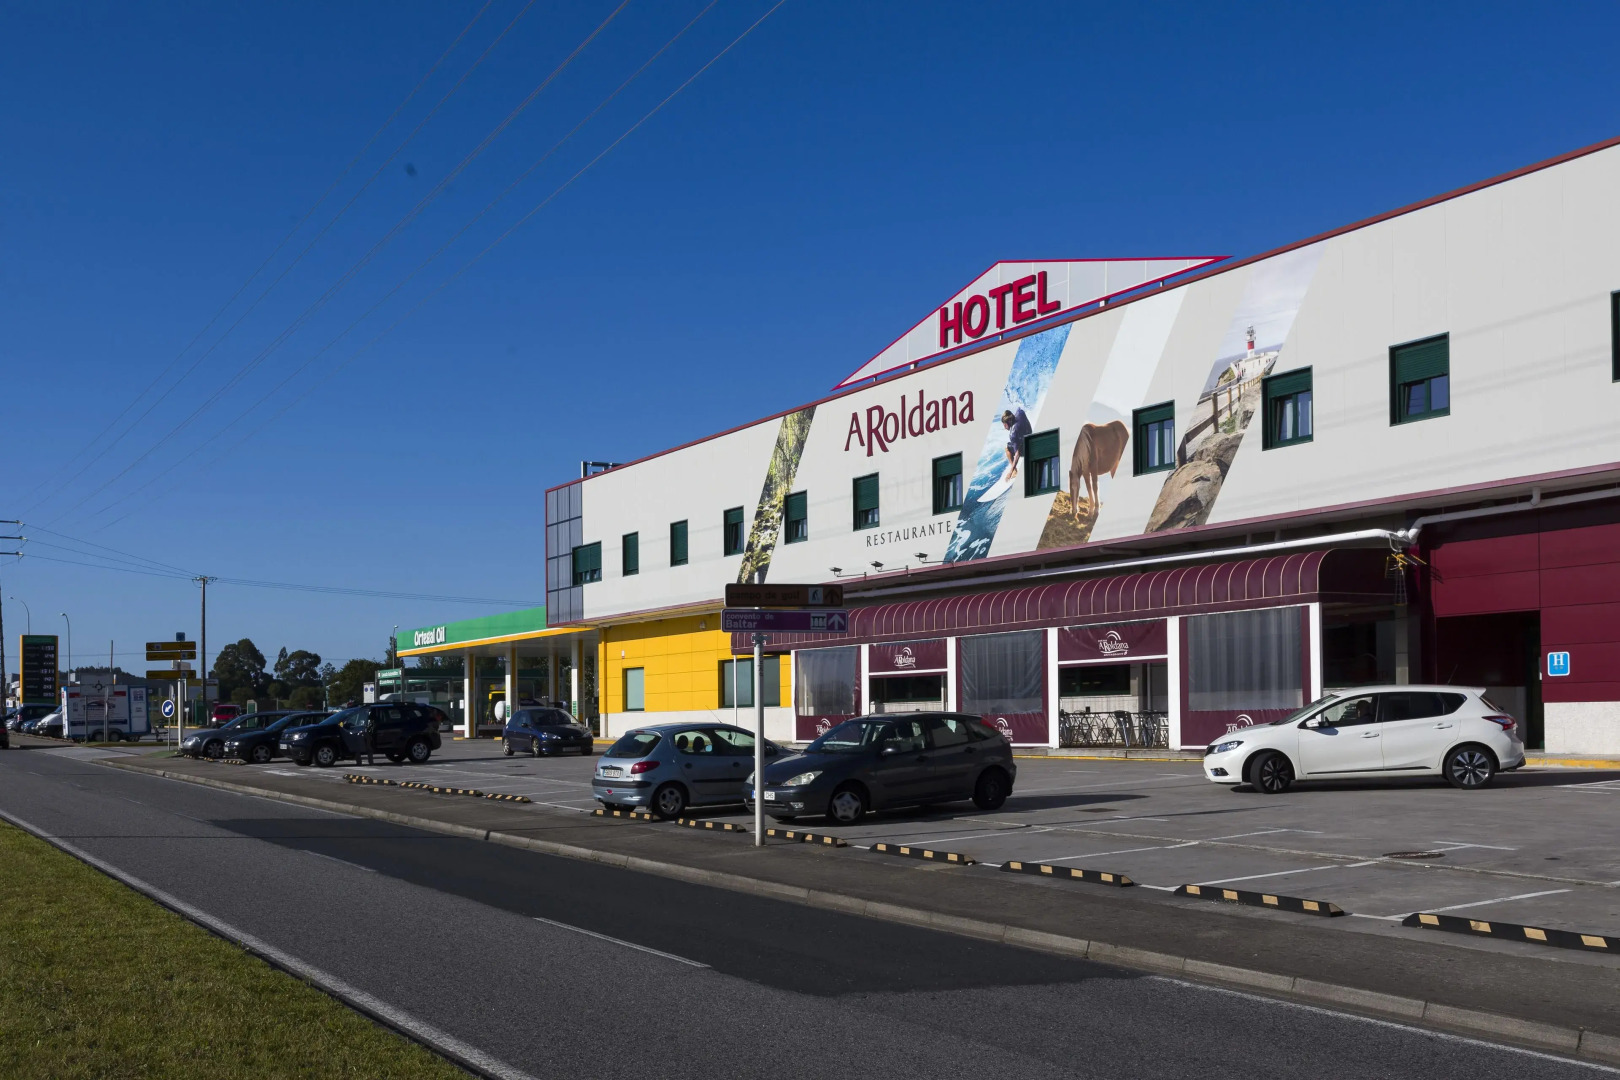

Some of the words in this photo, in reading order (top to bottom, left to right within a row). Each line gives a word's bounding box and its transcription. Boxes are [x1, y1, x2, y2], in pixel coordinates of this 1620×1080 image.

[940, 270, 1060, 348] HOTEL
[866, 520, 952, 547] RESTAURANTE
[729, 591, 761, 602] campo
[765, 591, 777, 599] de
[782, 590, 801, 601] golf
[726, 619, 758, 629] Baltar
[436, 625, 446, 643] Oil
